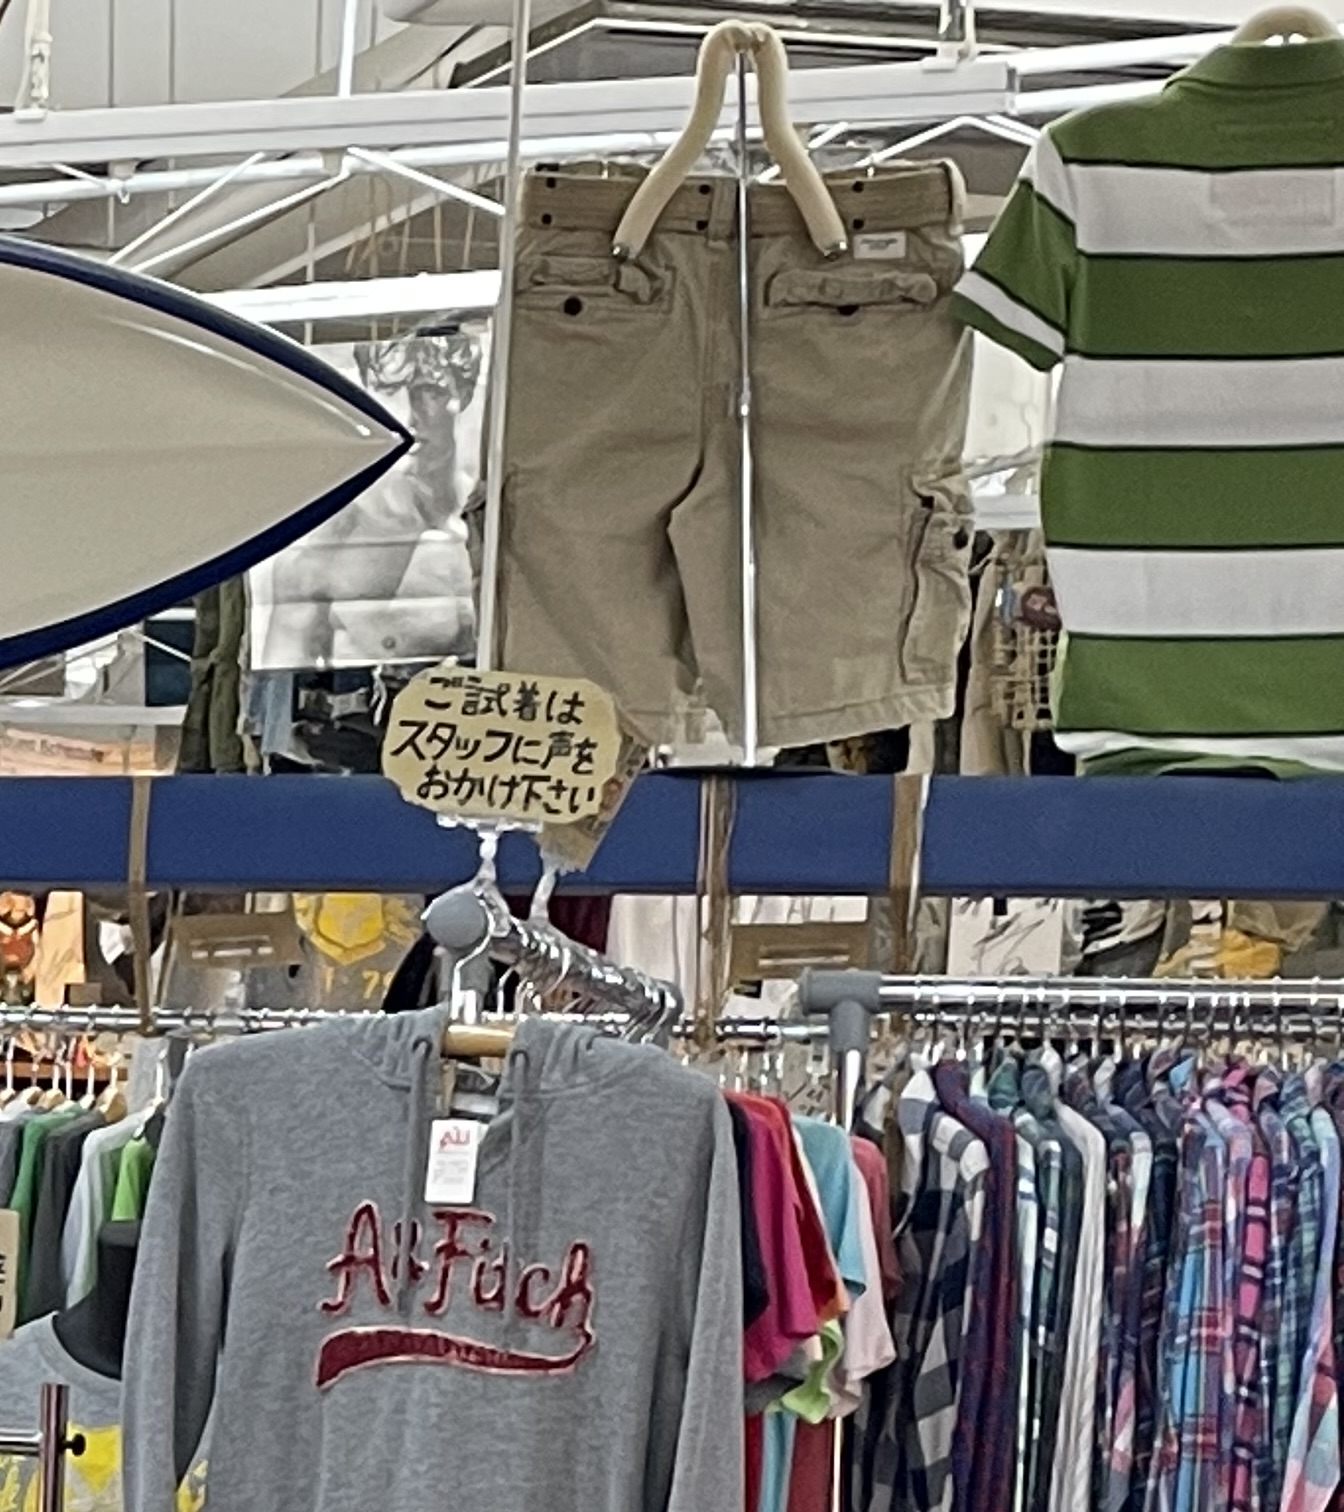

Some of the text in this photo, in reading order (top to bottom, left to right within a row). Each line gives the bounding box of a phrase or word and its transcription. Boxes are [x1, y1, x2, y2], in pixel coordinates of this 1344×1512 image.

[424, 677, 585, 725] ご試着は
[390, 720, 598, 775] スタッフに声を
[416, 764, 595, 815] おかけ下さい
